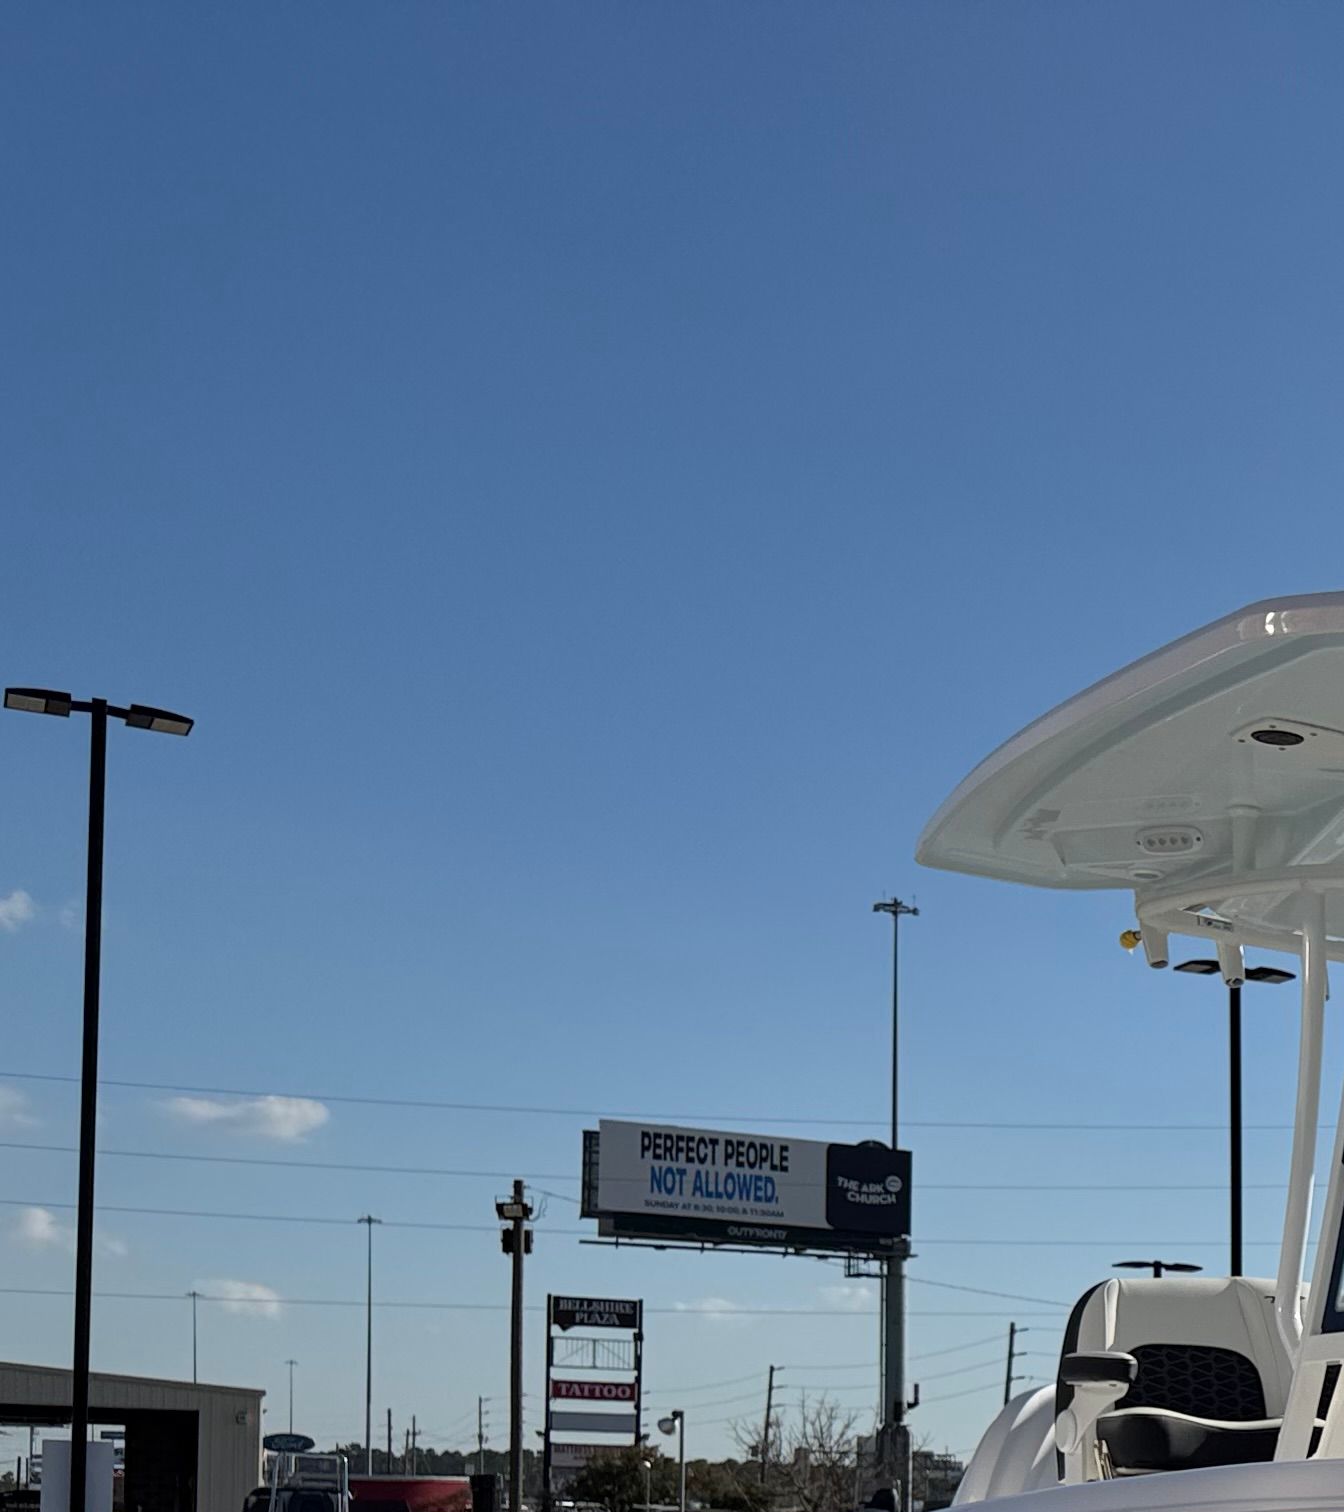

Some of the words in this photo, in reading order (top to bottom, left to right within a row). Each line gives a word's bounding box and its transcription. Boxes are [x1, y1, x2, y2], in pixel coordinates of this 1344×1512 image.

[641, 1130, 719, 1166] PERFECT
[724, 1139, 789, 1172] PEOPLE
[650, 1166, 687, 1196] NOT
[692, 1169, 779, 1204] ALLOWED.
[838, 1176, 860, 1191] THE
[861, 1182, 884, 1193] ARK
[644, 1199, 679, 1209] SUNDAY
[847, 1191, 897, 1205] CHURCH
[575, 1312, 620, 1325] PLAZA
[559, 1383, 632, 1398] TATTOO
